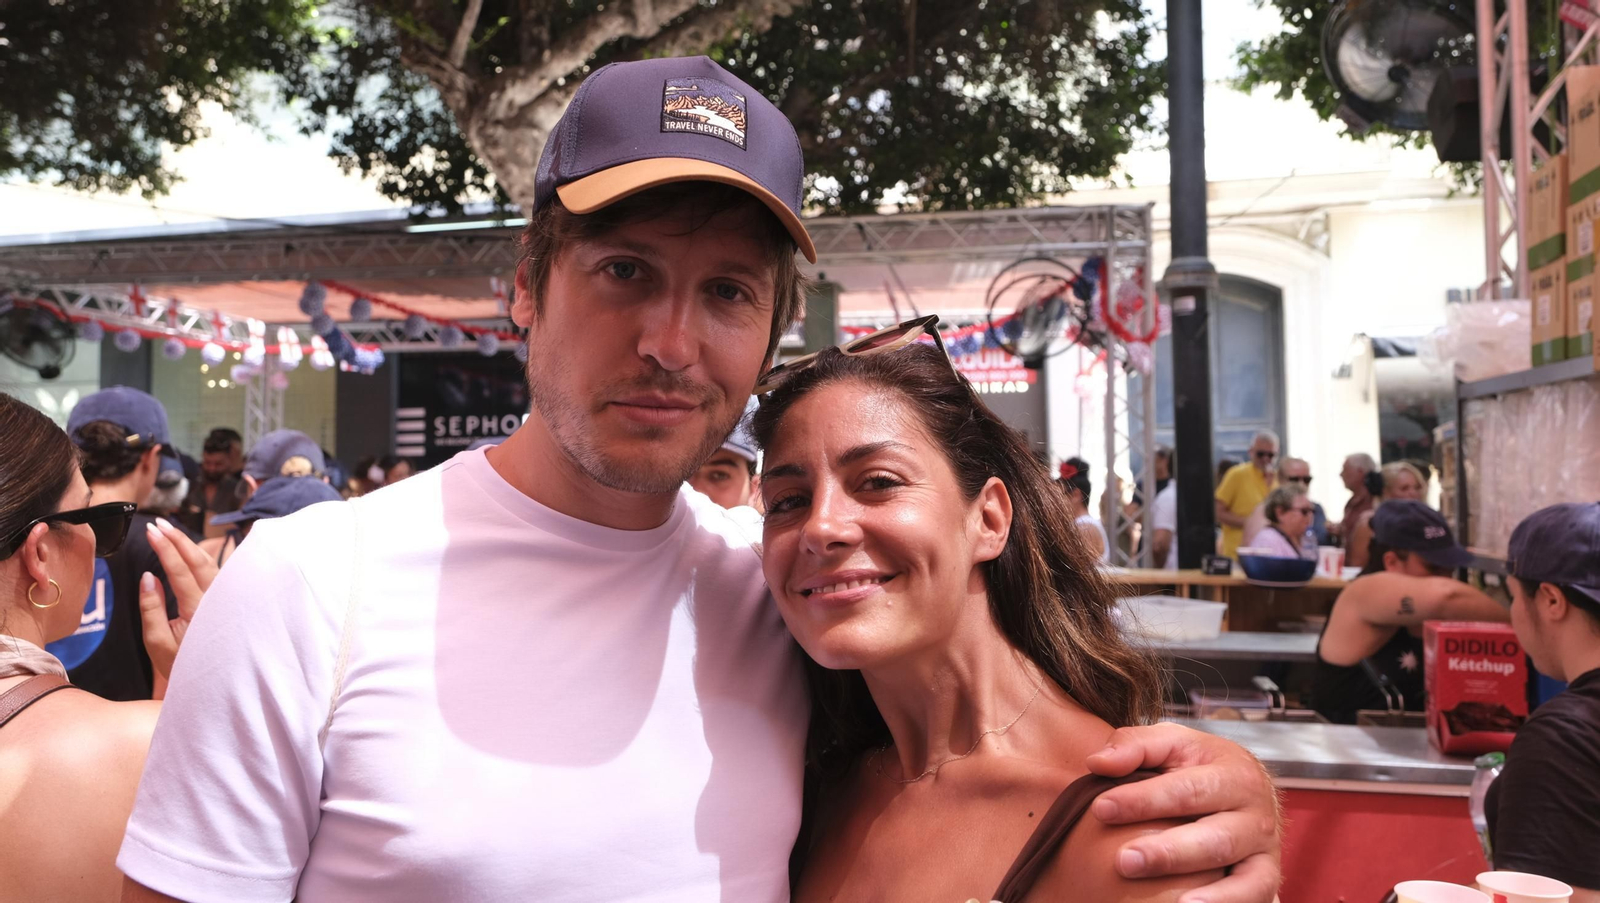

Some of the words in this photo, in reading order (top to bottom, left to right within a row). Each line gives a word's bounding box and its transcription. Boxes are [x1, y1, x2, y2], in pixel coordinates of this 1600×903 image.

[665, 121, 695, 130] TRAVEL
[697, 123, 724, 137] NEVER
[725, 131, 744, 145] ENDS
[1445, 638, 1519, 657] DIDILO
